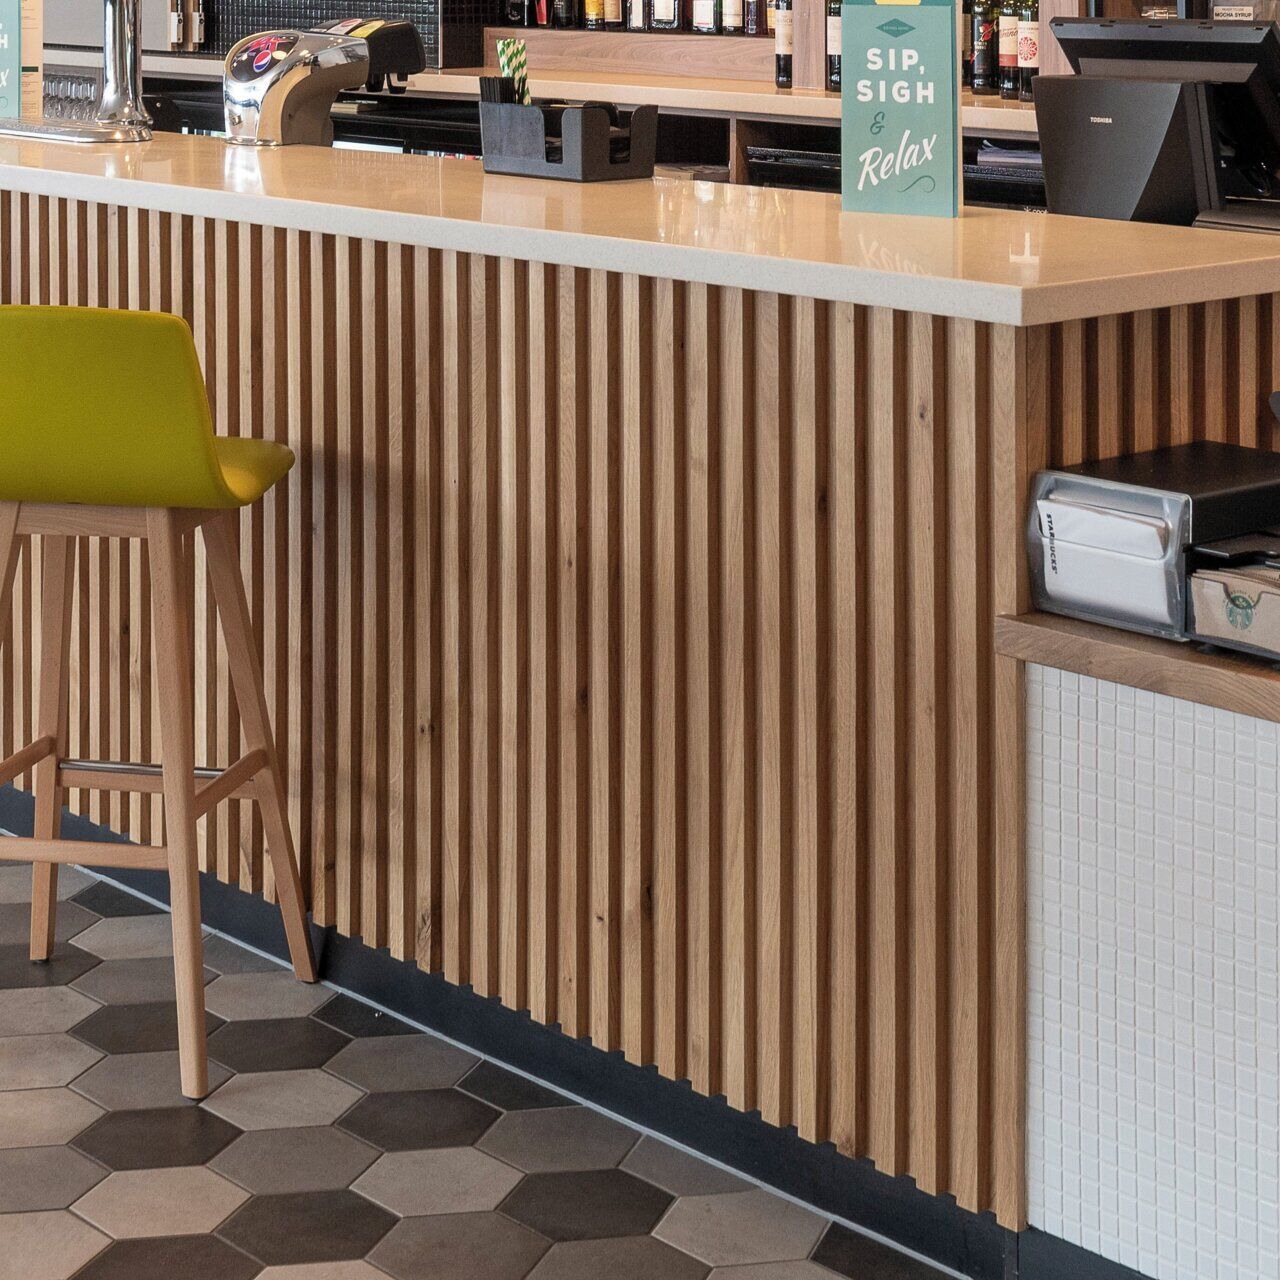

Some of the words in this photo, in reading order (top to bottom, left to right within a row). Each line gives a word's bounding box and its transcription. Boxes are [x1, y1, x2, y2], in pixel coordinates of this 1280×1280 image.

[866, 47, 925, 75] SIP,
[856, 79, 935, 104] SIGH
[870, 111, 885, 136] &
[857, 129, 938, 192] Relax
